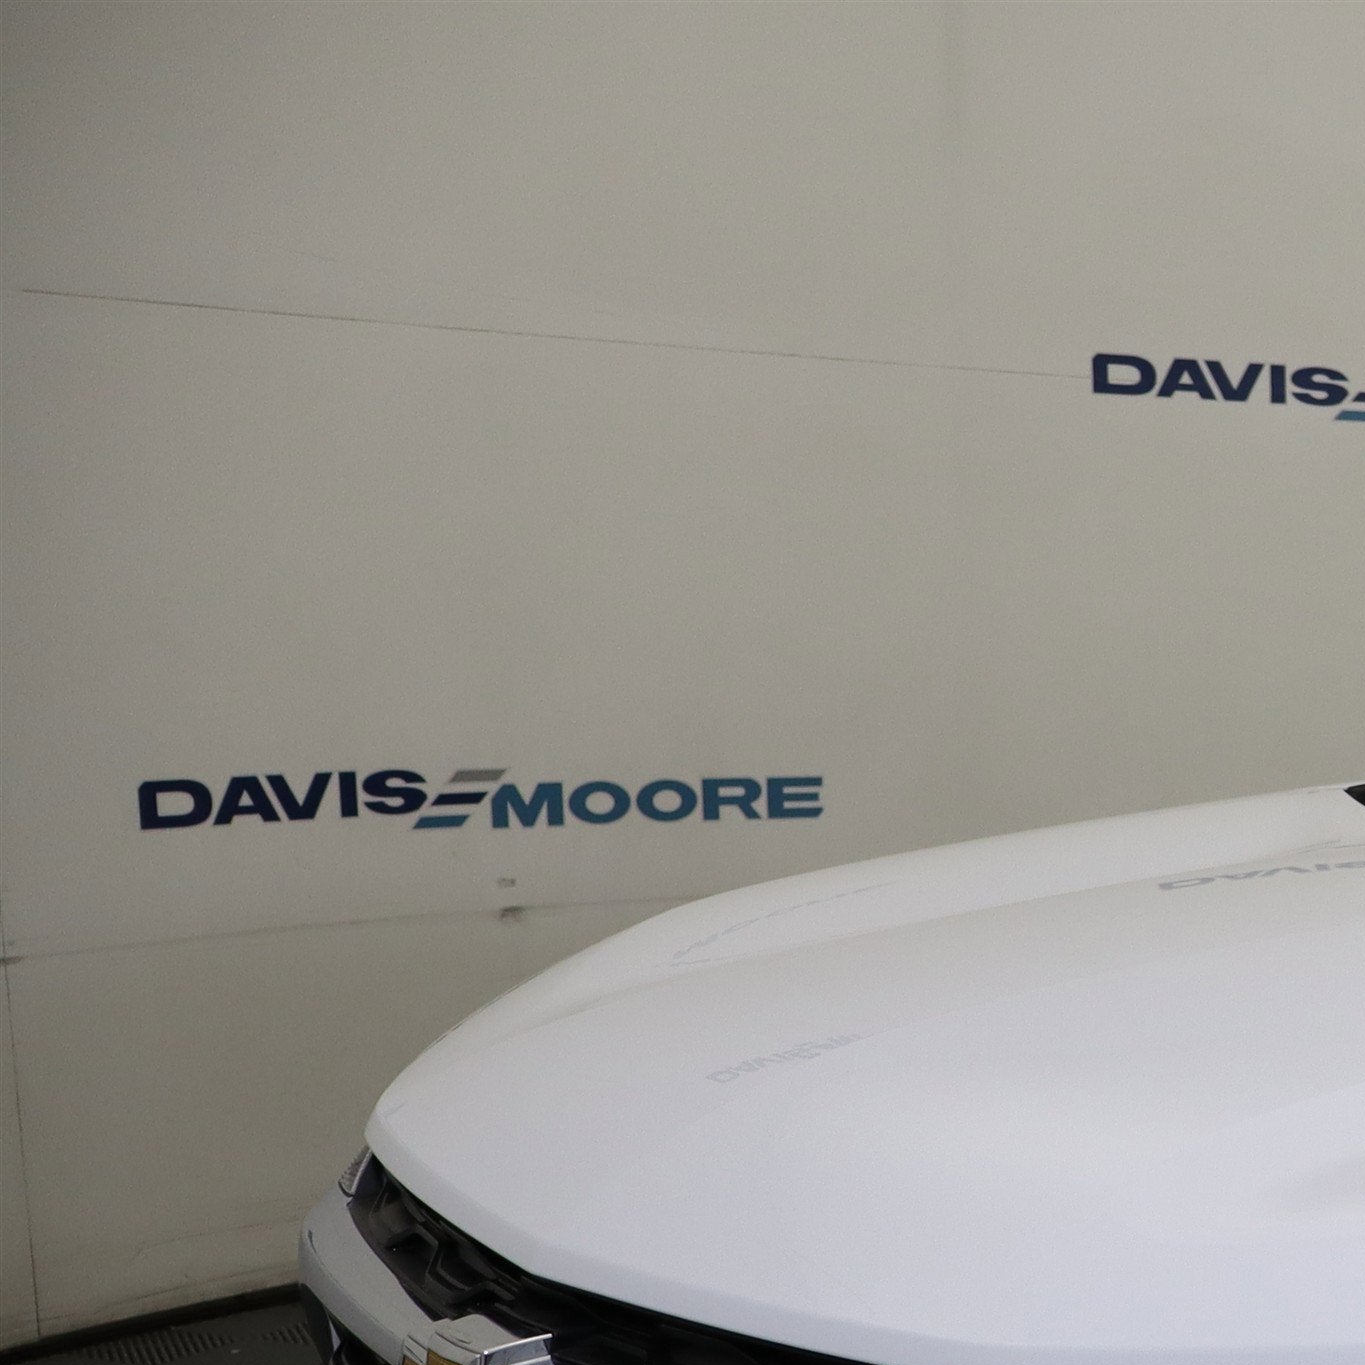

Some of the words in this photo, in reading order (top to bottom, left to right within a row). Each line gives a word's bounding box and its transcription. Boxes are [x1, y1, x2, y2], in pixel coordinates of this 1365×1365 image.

[1092, 353, 1350, 407] DAVIS
[137, 769, 429, 831] DAVIS
[491, 776, 824, 829] MOORE
